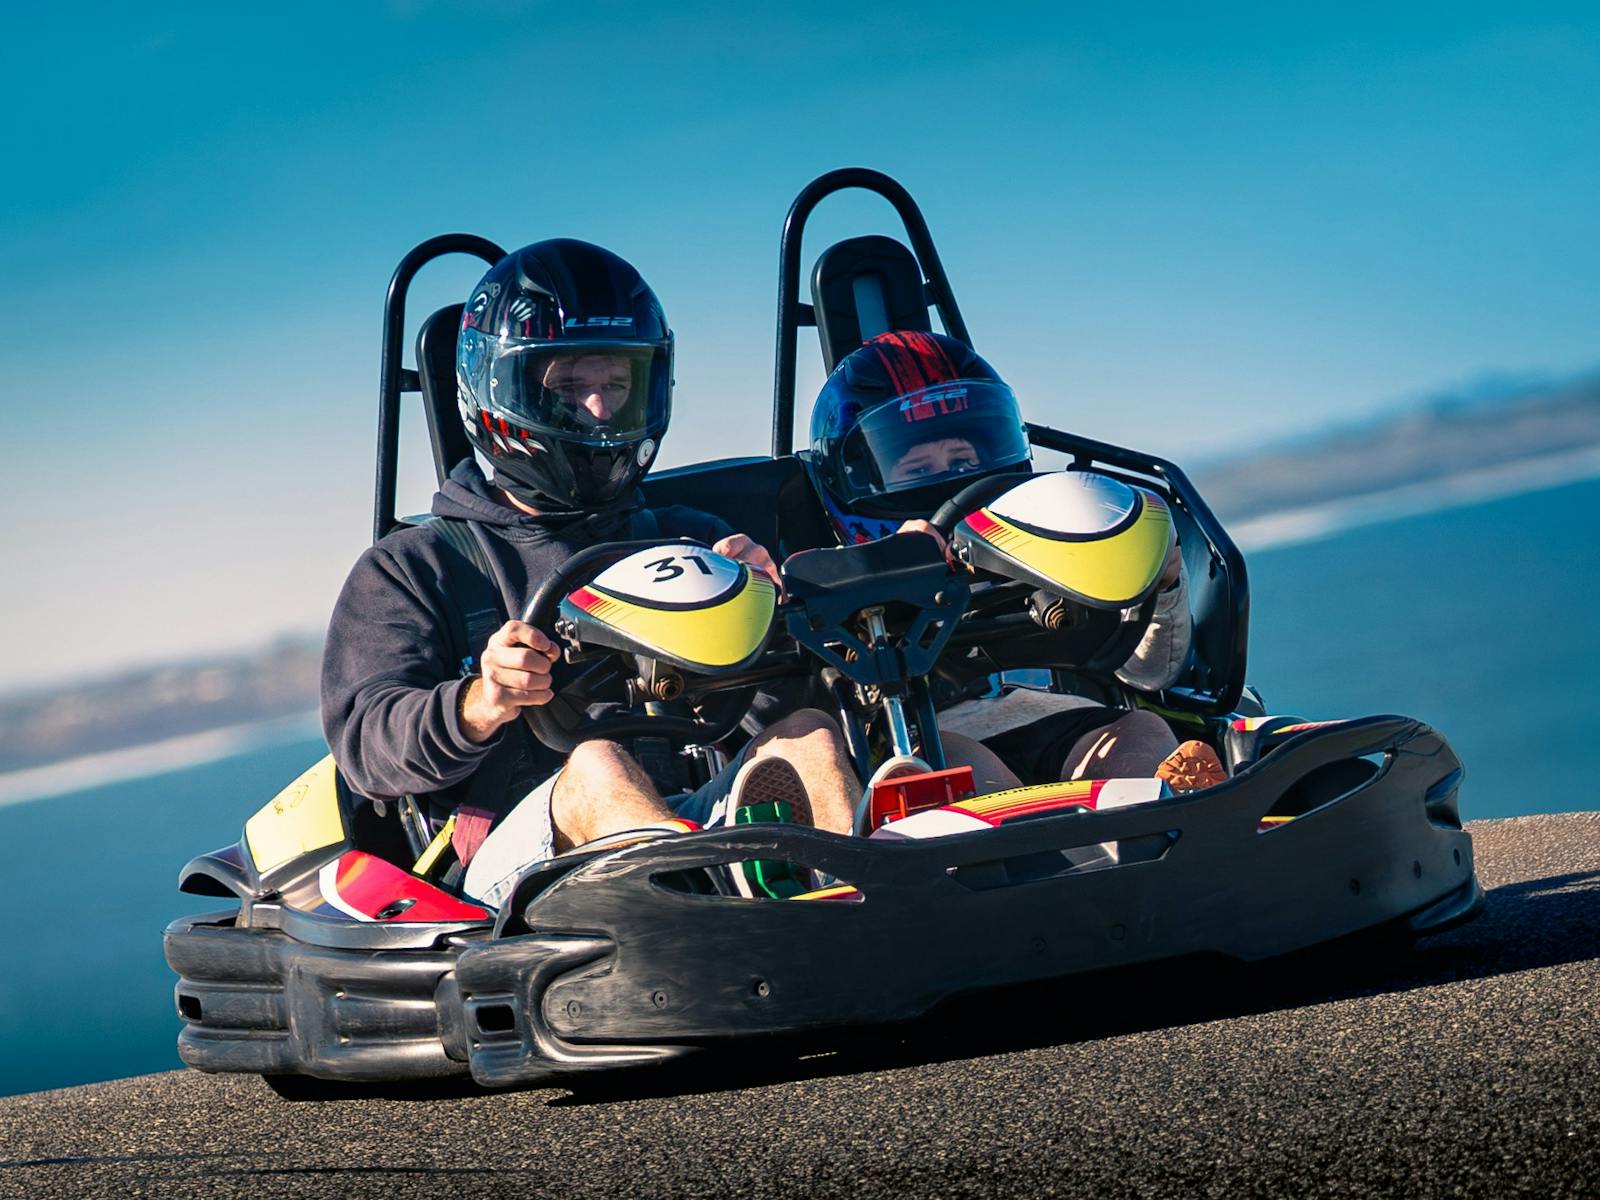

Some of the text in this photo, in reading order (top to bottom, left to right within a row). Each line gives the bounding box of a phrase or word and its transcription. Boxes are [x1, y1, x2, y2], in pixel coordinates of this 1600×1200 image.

[565, 316, 634, 328] LS2
[900, 388, 968, 411] LS2
[643, 555, 713, 583] 31
